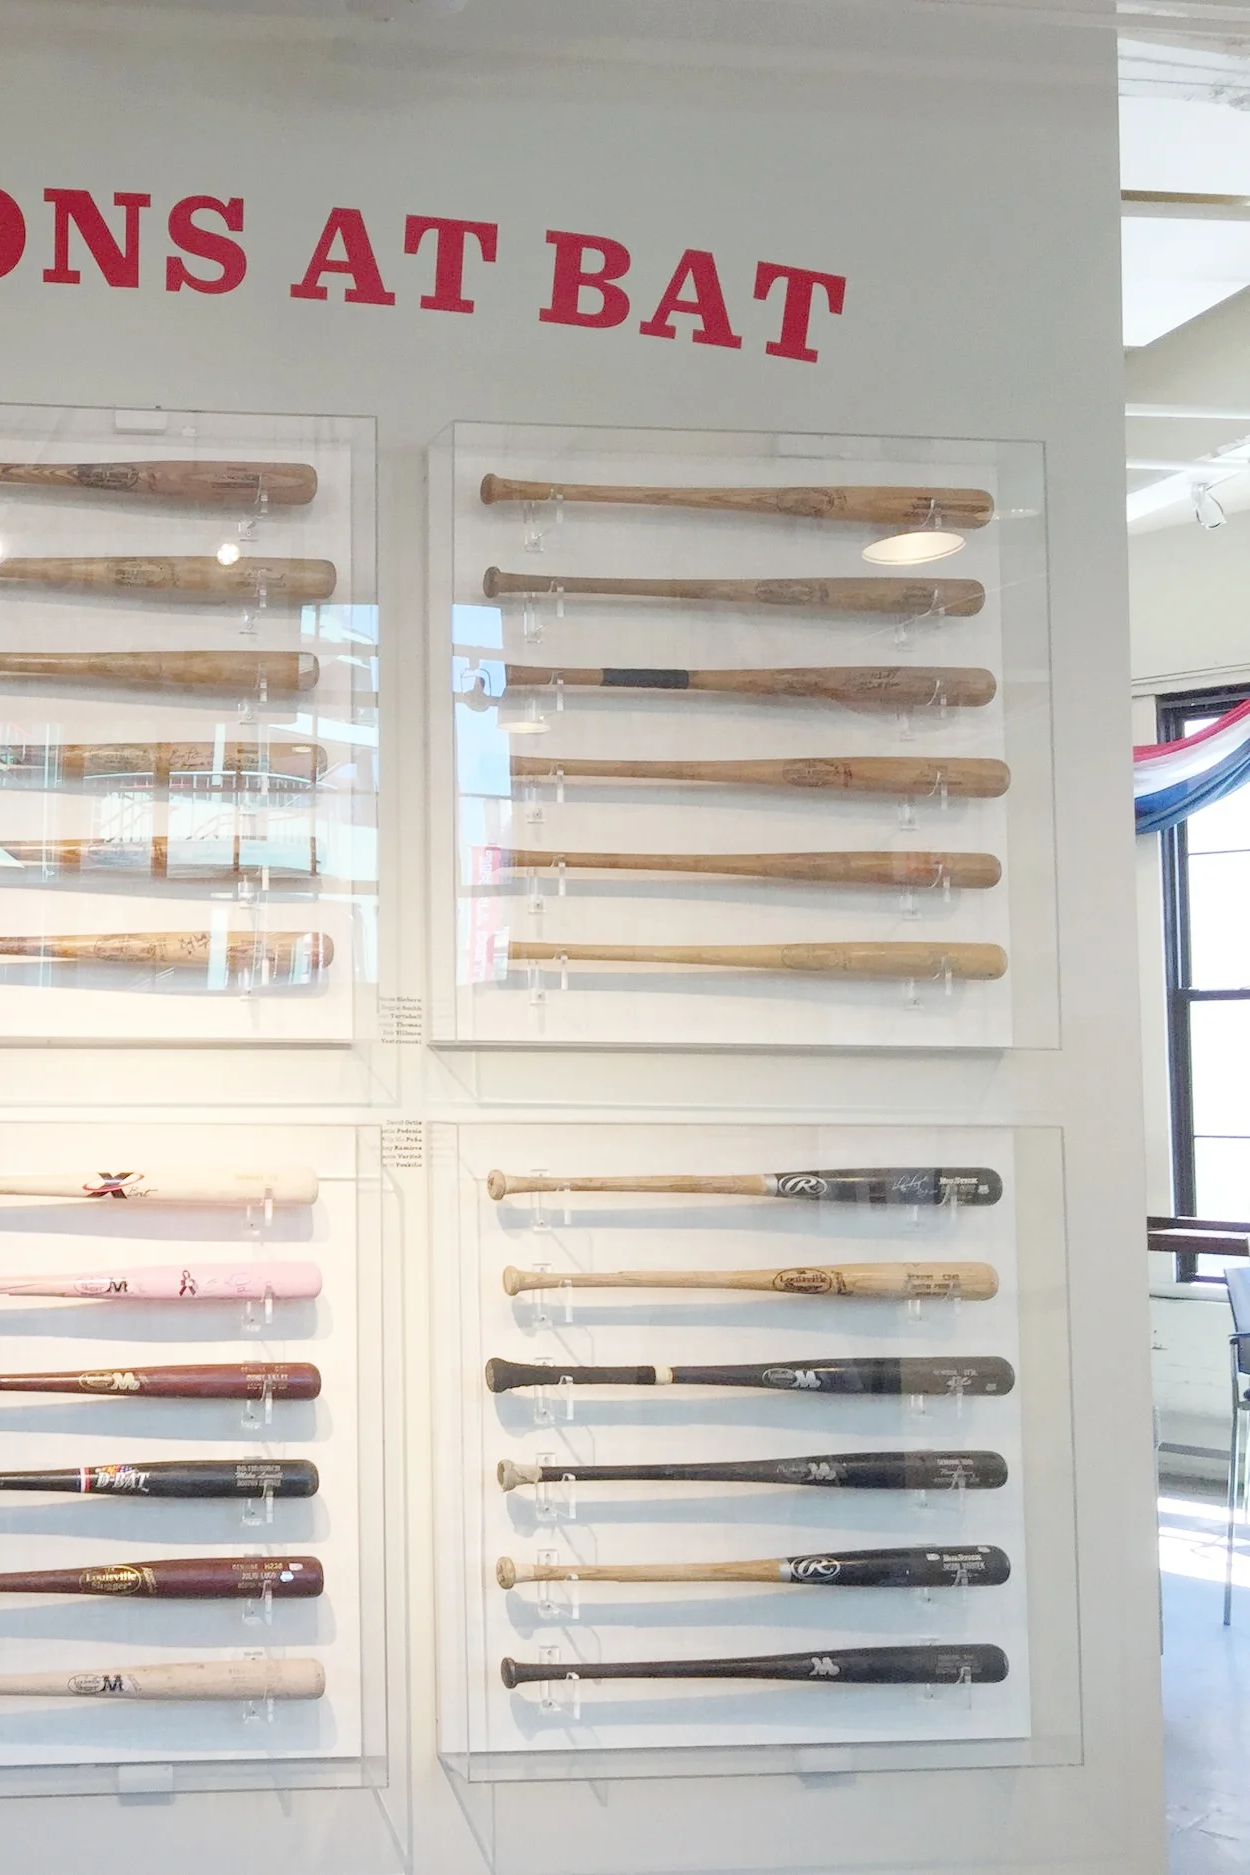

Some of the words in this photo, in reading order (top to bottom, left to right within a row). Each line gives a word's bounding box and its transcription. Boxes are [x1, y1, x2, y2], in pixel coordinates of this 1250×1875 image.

[289, 206, 498, 314] AT
[538, 228, 847, 364] BAT
[95, 1469, 150, 1492] D-BAT
